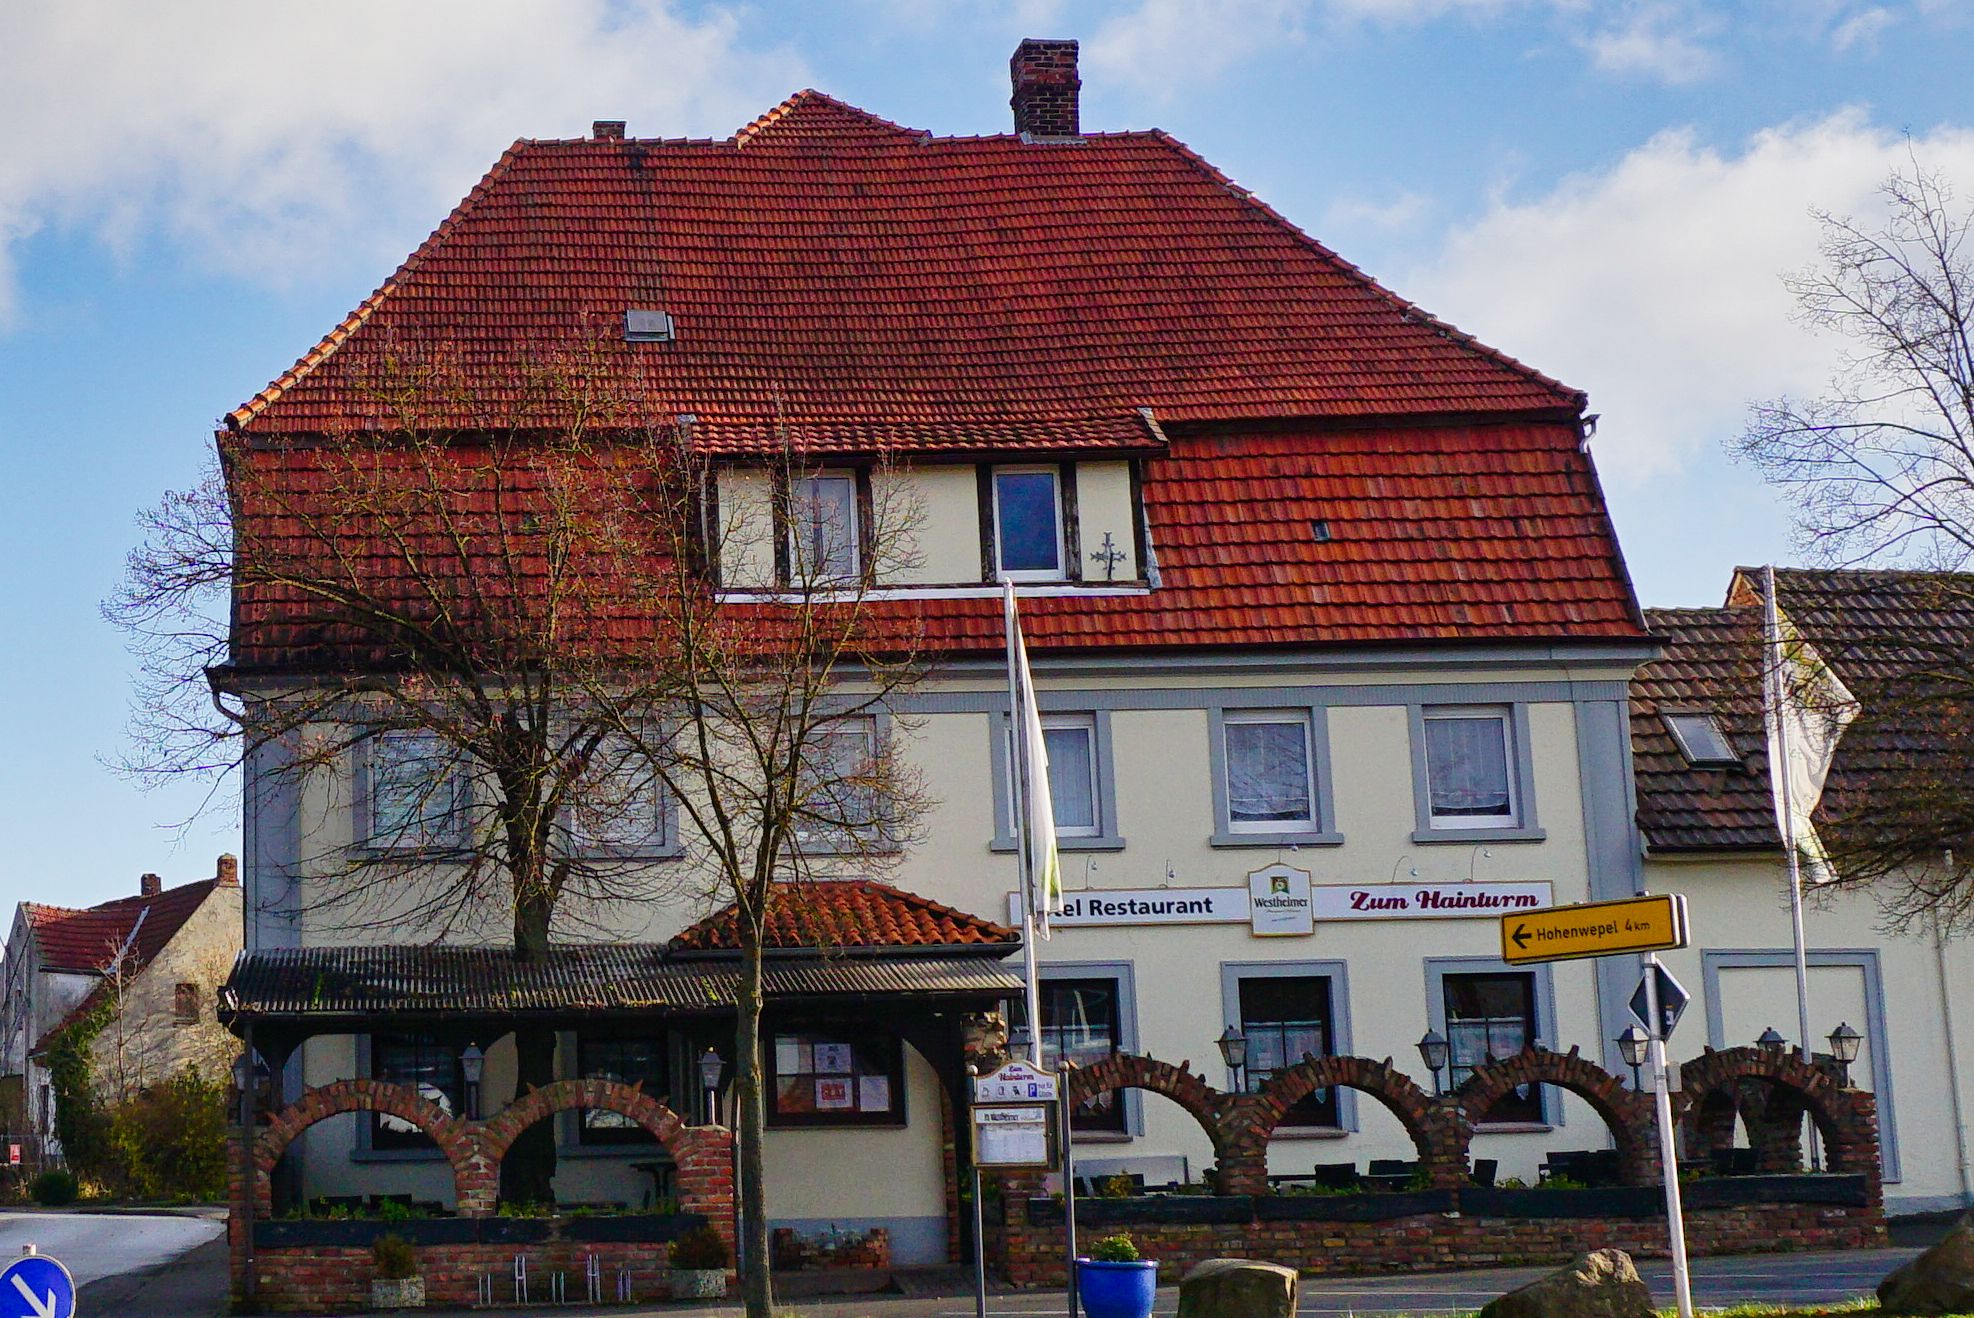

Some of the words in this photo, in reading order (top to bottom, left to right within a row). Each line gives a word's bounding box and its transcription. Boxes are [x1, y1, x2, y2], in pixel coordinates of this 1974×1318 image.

[1089, 897, 1213, 916] Restaurant
[1253, 896, 1308, 908] Westheimer
[1350, 891, 1409, 911] Zum
[1415, 890, 1540, 909] Hainturm
[1536, 921, 1618, 942] Hohenwepel
[1624, 918, 1633, 932] 4
[1634, 920, 1651, 931] km
